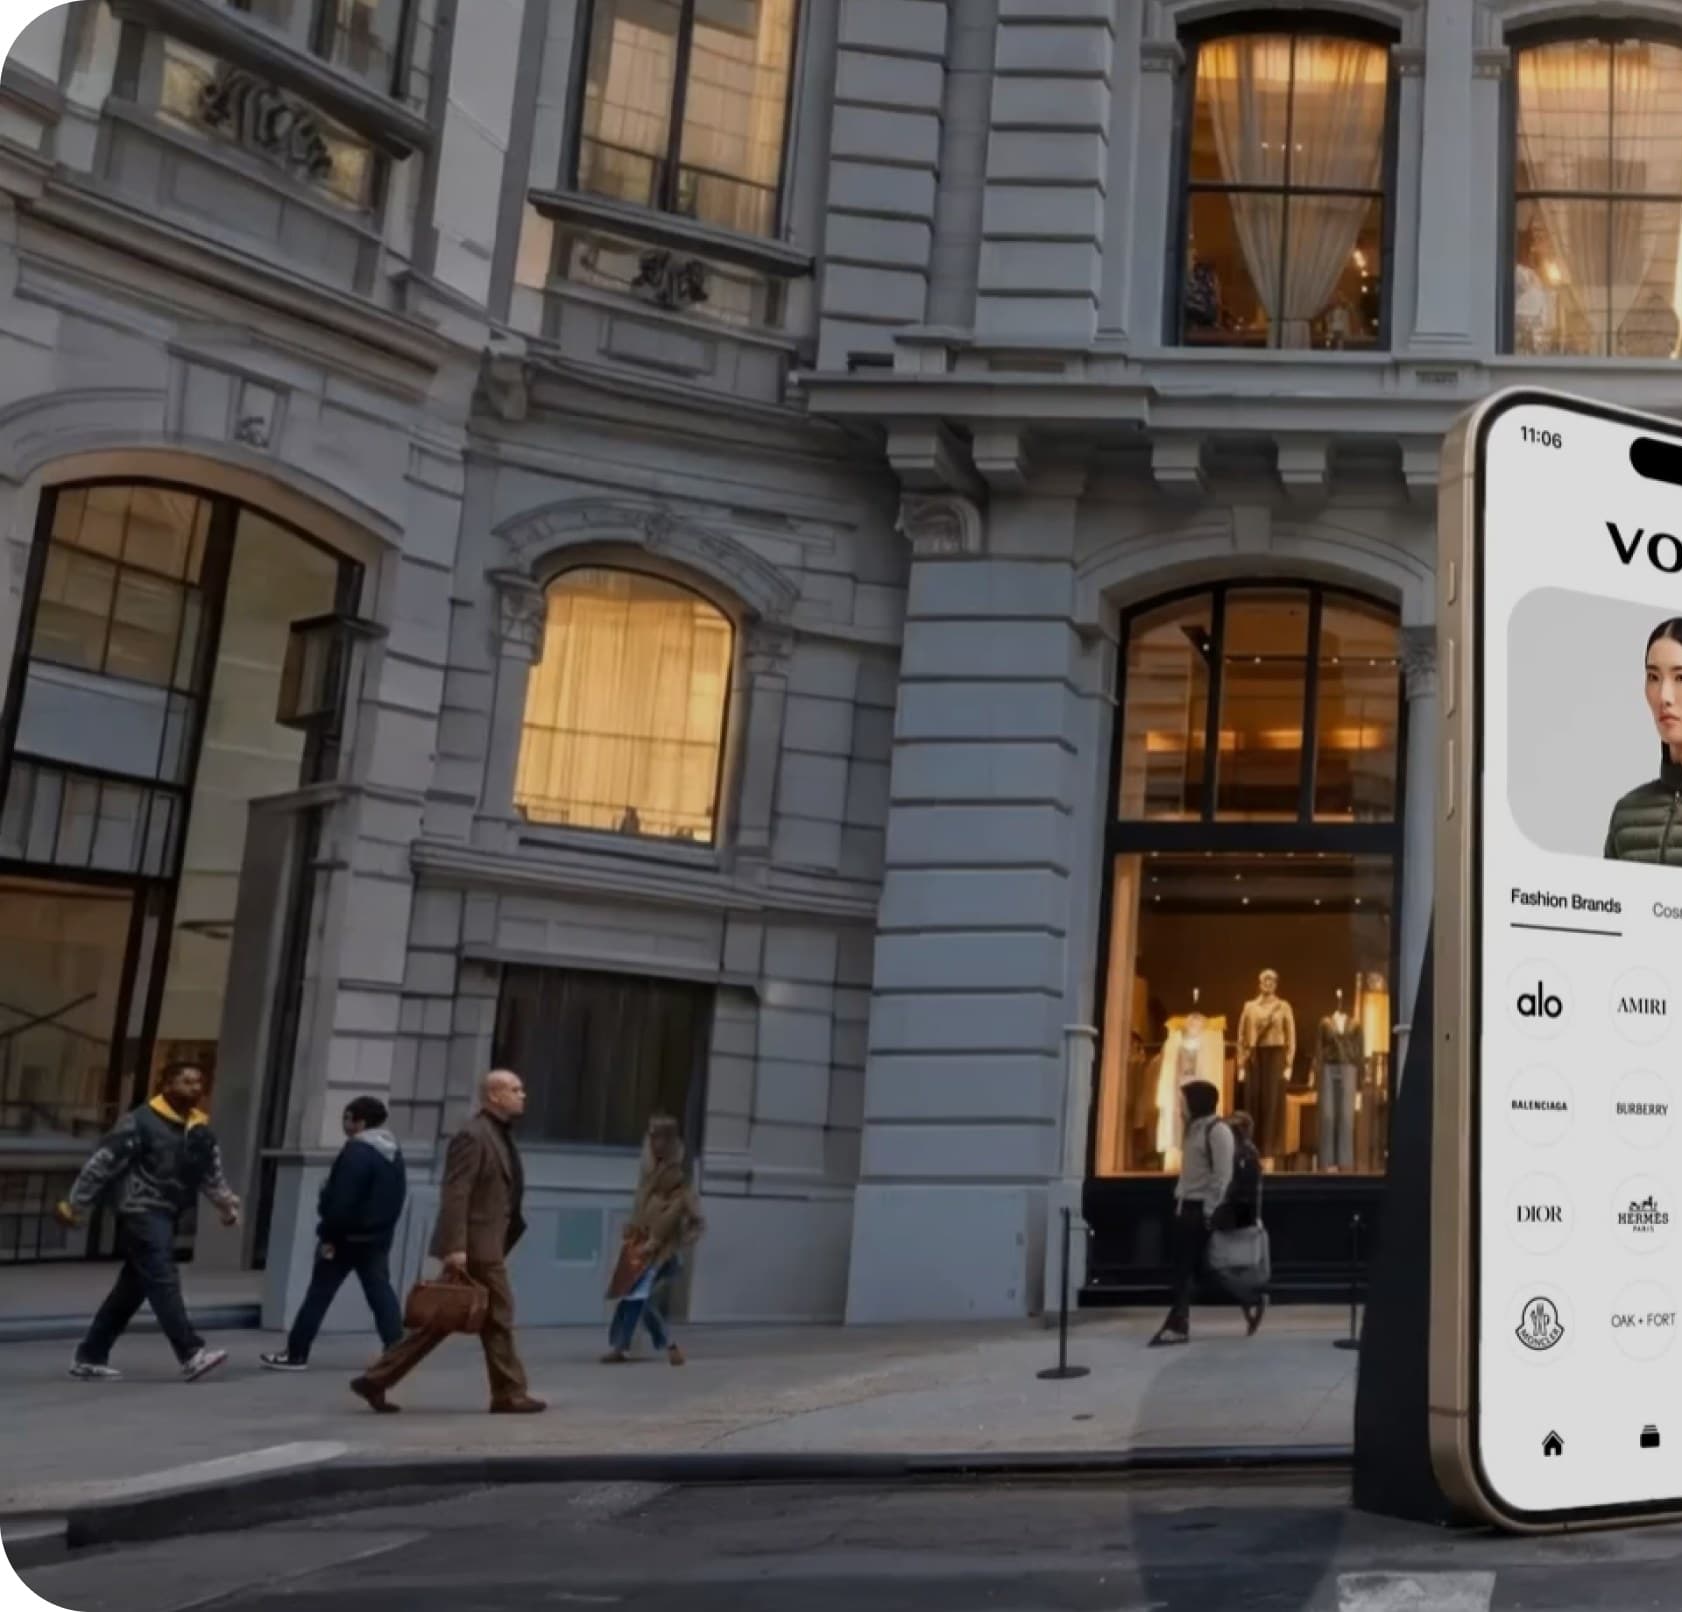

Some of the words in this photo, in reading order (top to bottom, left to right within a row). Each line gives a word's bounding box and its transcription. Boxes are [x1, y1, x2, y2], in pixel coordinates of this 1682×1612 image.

[1520, 425, 1563, 449] 11:06
[1511, 887, 1568, 909] Fashion
[1571, 893, 1622, 915] Brands
[1516, 979, 1564, 1019] alo
[1617, 996, 1667, 1016] AMIRI
[1511, 1099, 1569, 1112] BALENCIAGA
[1616, 1101, 1669, 1117] BURBERRY
[1516, 1204, 1563, 1223] DIOR
[1610, 1313, 1636, 1328] OAK
[1646, 1312, 1676, 1327] FORT
[1520, 1328, 1561, 1347] MONCLER
